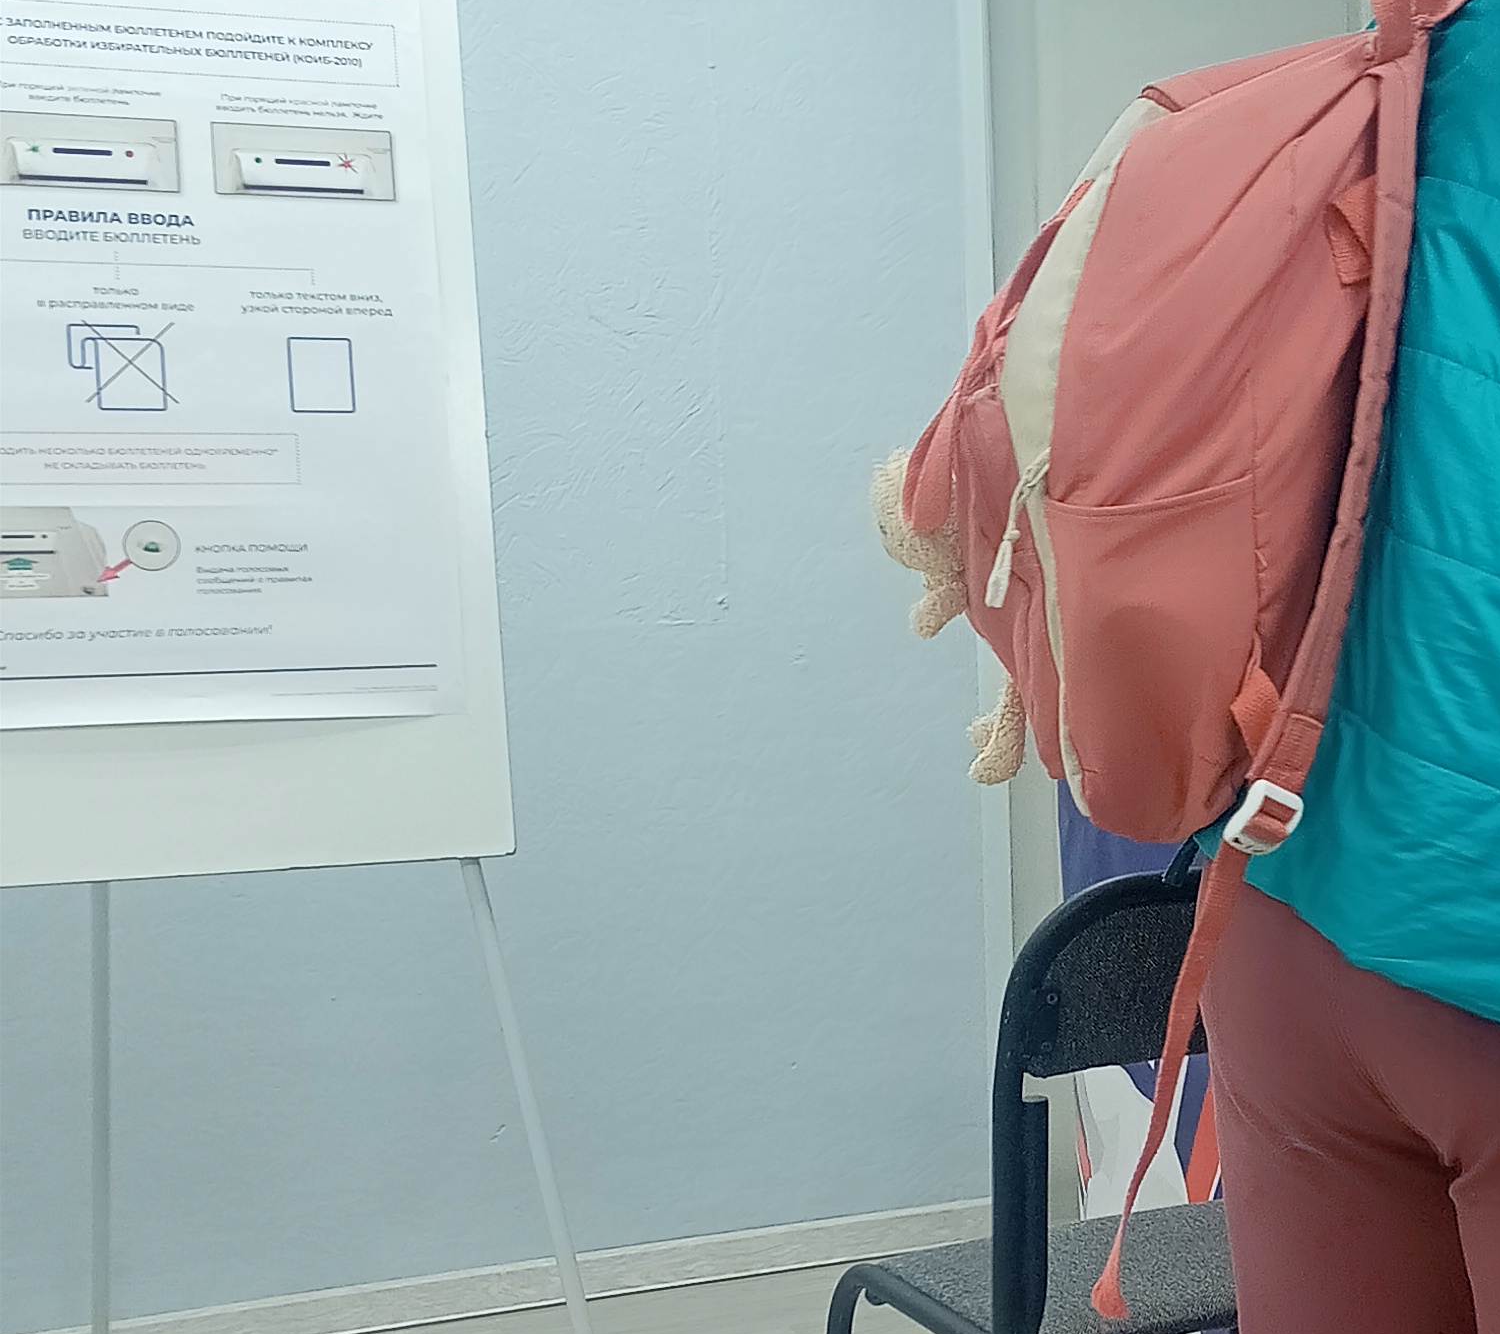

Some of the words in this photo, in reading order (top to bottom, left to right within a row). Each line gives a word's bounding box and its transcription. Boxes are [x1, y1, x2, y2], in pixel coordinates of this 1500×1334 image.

[6, 17, 112, 34] ЗАПОЛНЕННЫМ
[114, 25, 203, 40] БЮЛЛЕТЕНЕМ
[206, 30, 285, 45] ПОДОЙДИТЕ
[288, 36, 296, 45] К
[299, 37, 373, 51] КОМПЛЕКСУ
[7, 35, 87, 49] ОБРАБОТКИ
[90, 40, 202, 56] ИЗБИРАТЕЛЬНЫХ
[205, 48, 290, 63] БЮЛЛЕТЕНЕЙ
[293, 56, 362, 68] (КОИБ-2010)
[27, 208, 123, 224] ПРАВИЛА
[127, 212, 195, 227] ВВОДА
[22, 228, 100, 242] ВВОДИТЕ
[102, 231, 201, 246] БЮЛЛЕТЕНЬ
[249, 291, 293, 300] только
[296, 292, 346, 301] текстом
[282, 305, 343, 315] стороной
[248, 543, 308, 552] ПОМОЩИ
[0, 628, 63, 641] Спасибо
[66, 630, 86, 639] за
[88, 629, 151, 641] участие
